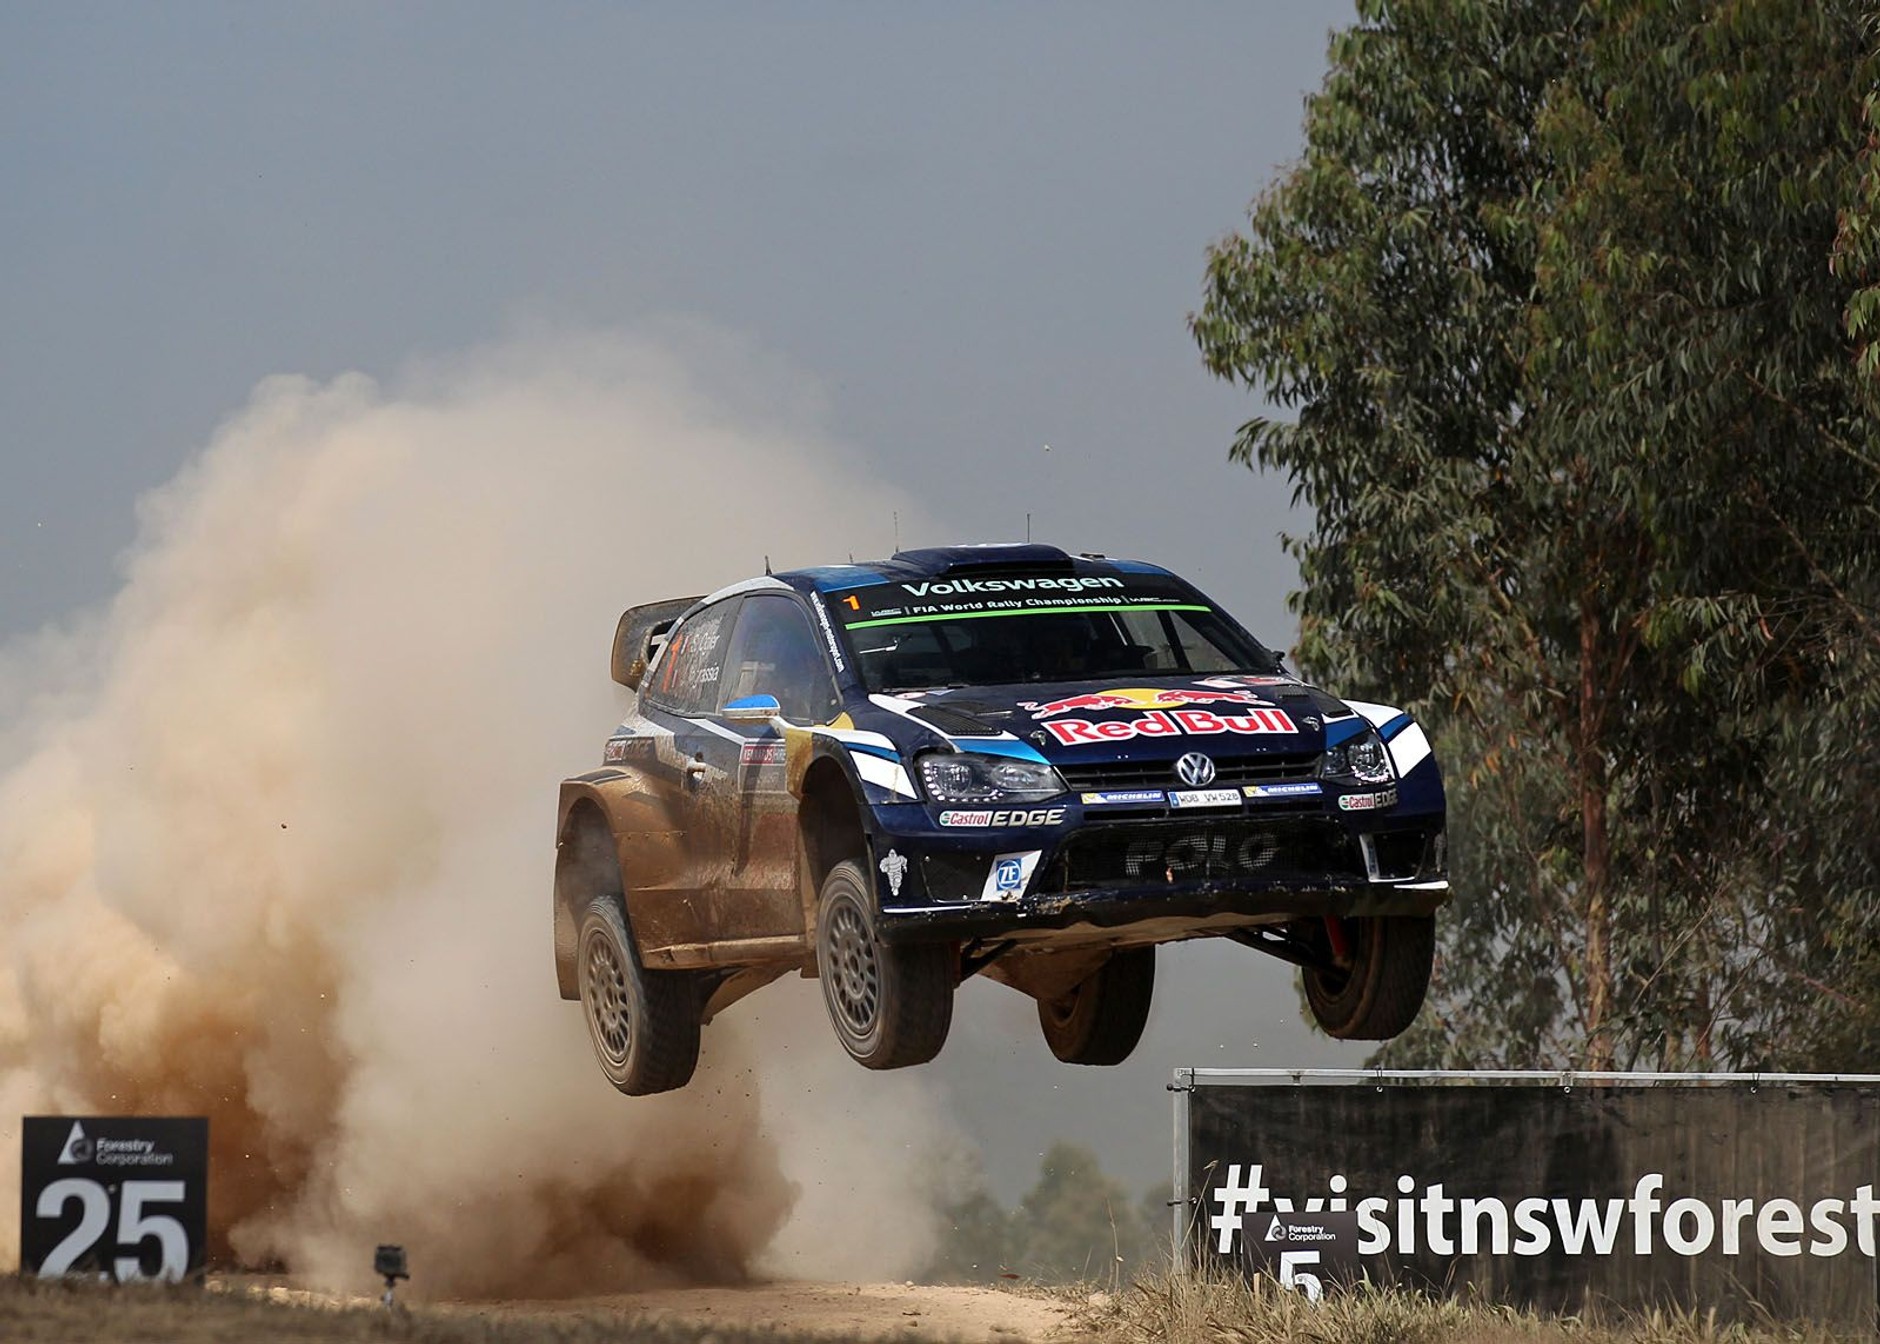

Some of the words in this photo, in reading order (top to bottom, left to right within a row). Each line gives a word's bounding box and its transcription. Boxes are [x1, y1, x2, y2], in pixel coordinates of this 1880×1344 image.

[901, 577, 1124, 597] Volkswagen
[842, 594, 860, 611] 1
[912, 605, 938, 614] FIA
[941, 601, 983, 612] World
[987, 598, 1022, 609] Rally
[1025, 596, 1122, 607] Championship
[1045, 711, 1178, 745] Red
[1171, 709, 1297, 734] Bull
[1106, 791, 1163, 801] MICHELIN
[1267, 784, 1319, 794] MICHELIN
[1350, 794, 1375, 809] Castrol
[1375, 788, 1399, 807] EDGE
[950, 811, 990, 826] Castrol
[990, 808, 1067, 827] EDGE
[1124, 832, 1281, 877] POLO
[1000, 866, 1018, 883] ZF
[96, 1137, 155, 1153] Forestry
[96, 1152, 173, 1166] Corporation
[1211, 1164, 1880, 1256] #sitnswforest
[36, 1177, 189, 1285] 25
[1288, 1225, 1324, 1234] Forestry
[1288, 1233, 1336, 1242] Corporation
[1280, 1250, 1324, 1304] 5
